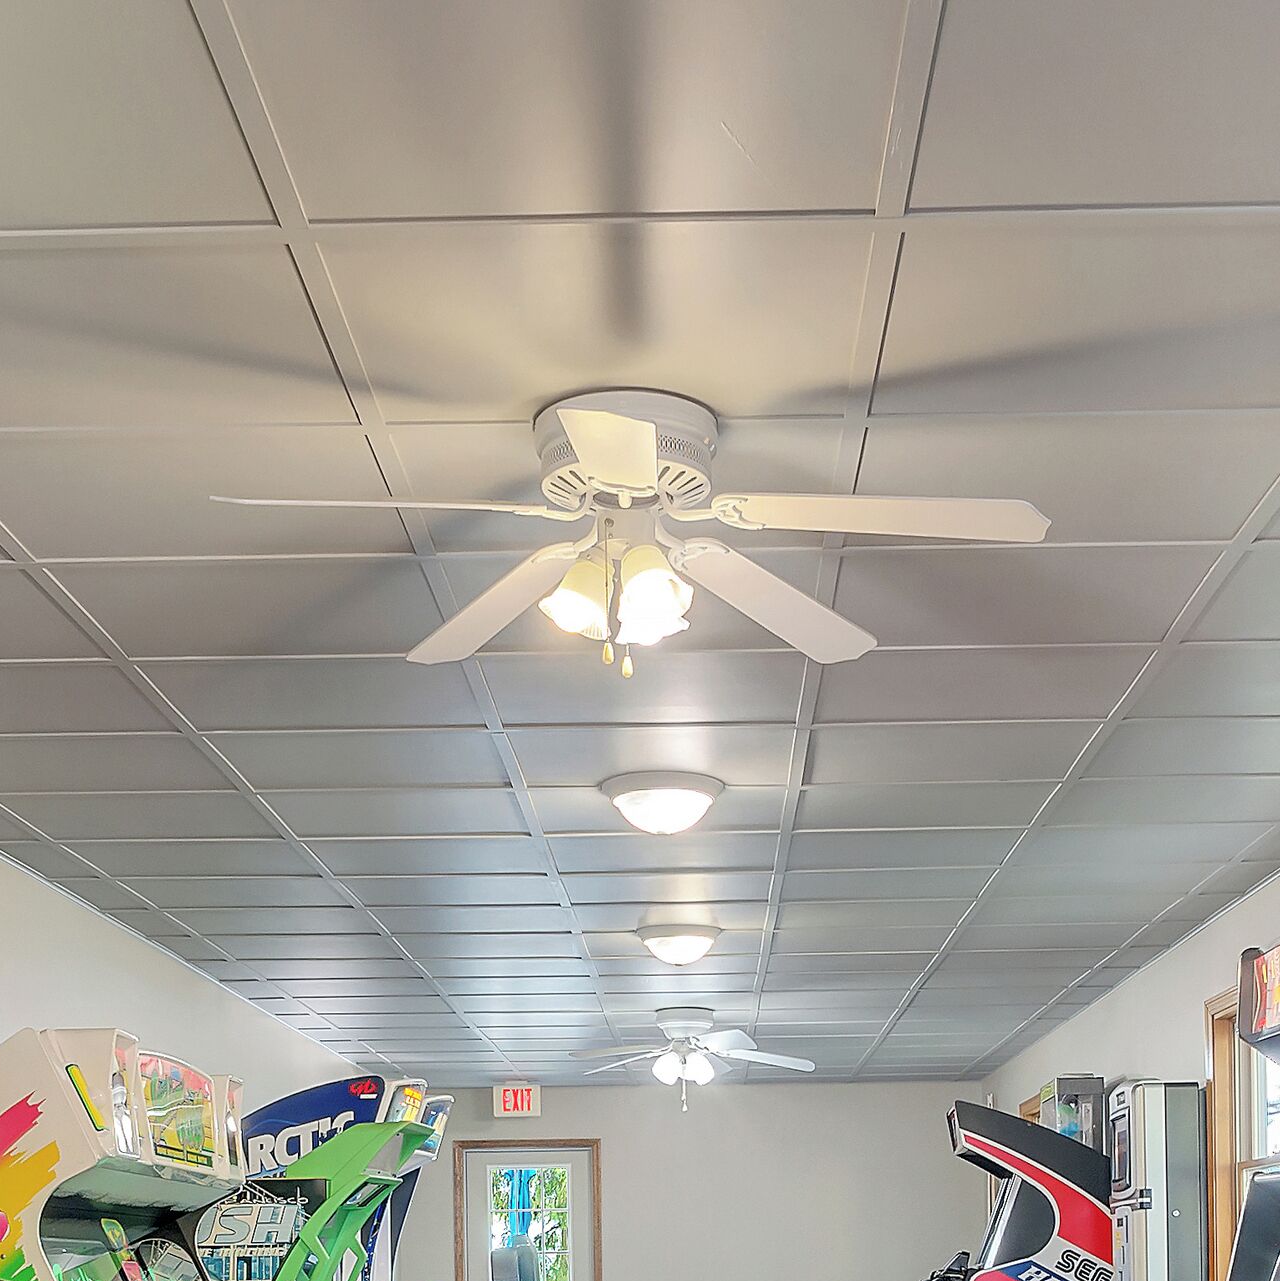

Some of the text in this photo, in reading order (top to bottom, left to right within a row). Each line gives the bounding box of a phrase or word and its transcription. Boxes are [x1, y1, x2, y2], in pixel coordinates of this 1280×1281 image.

[502, 1088, 532, 1112] EXIT
[248, 1111, 355, 1175] RCTIC
[197, 1205, 299, 1244] USH
